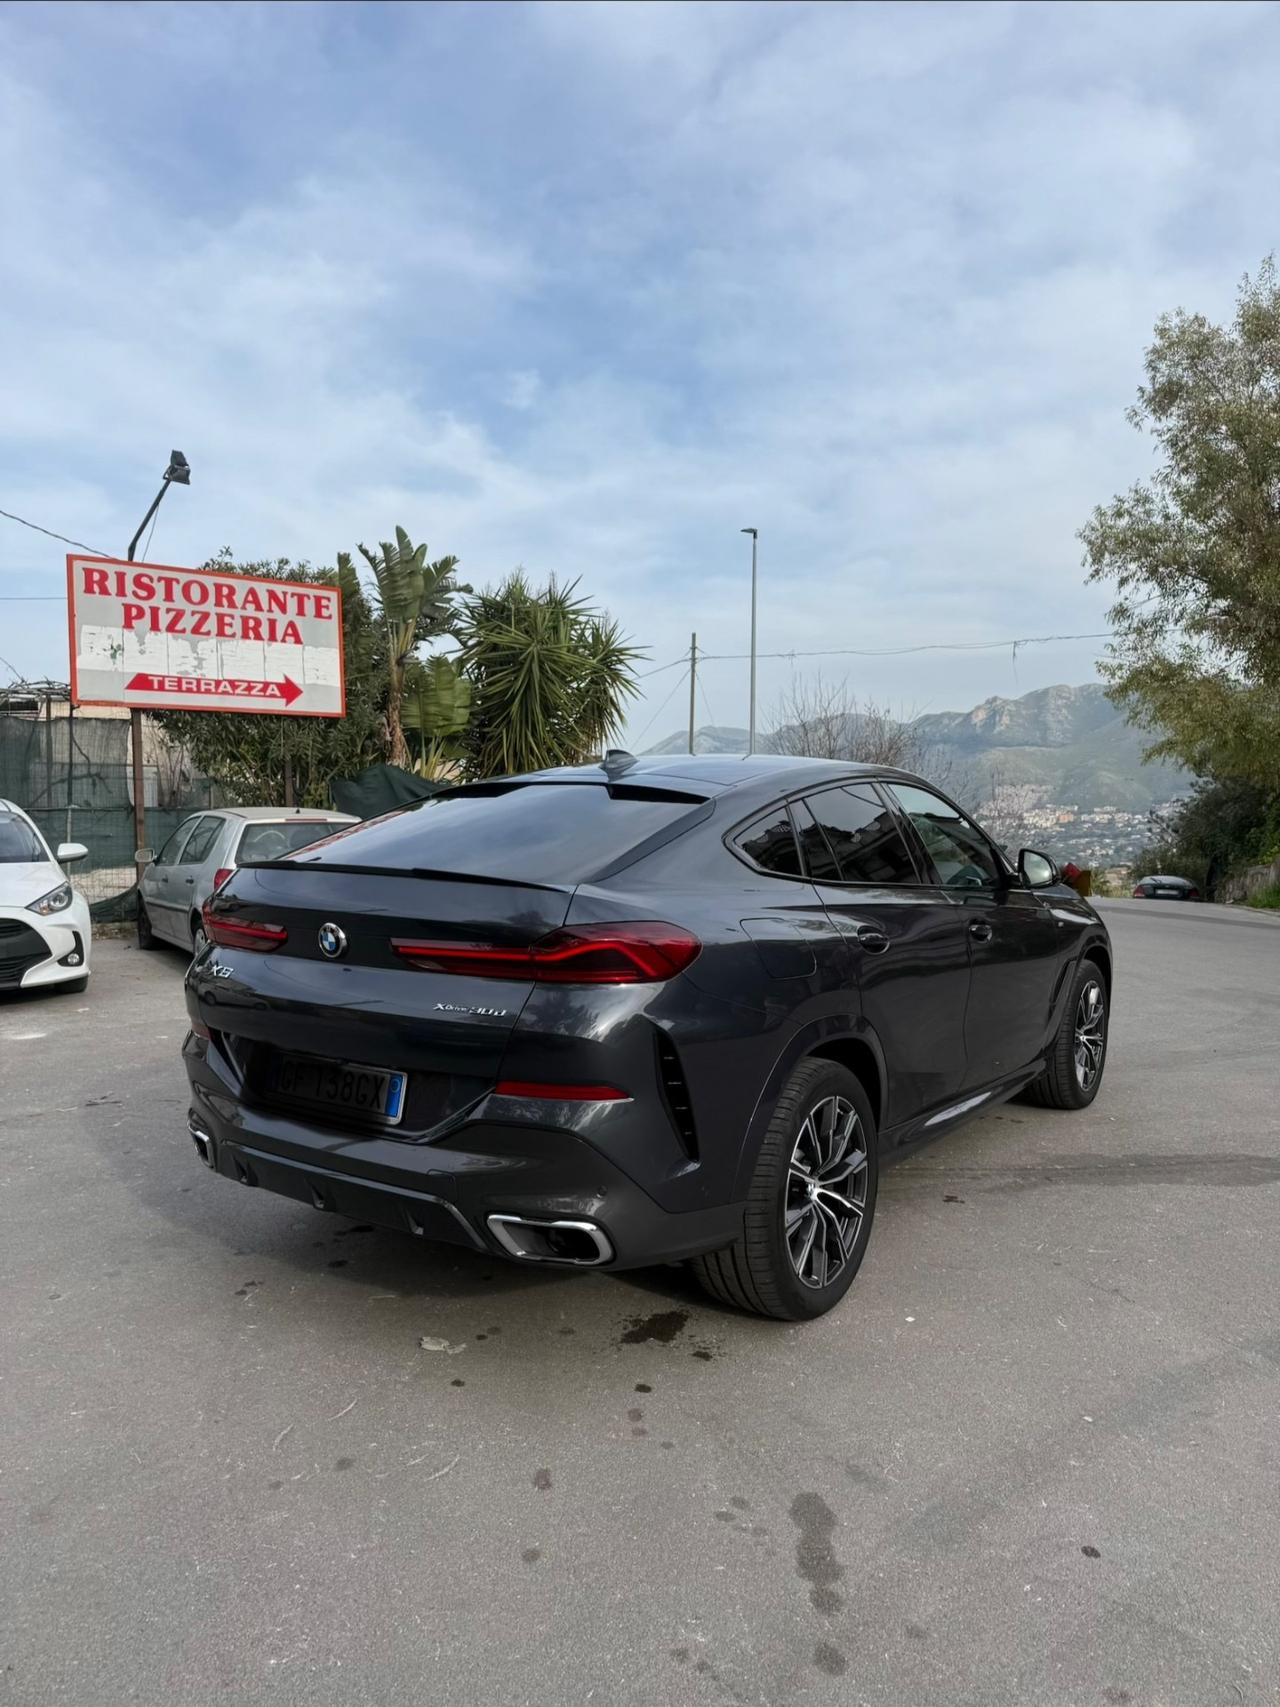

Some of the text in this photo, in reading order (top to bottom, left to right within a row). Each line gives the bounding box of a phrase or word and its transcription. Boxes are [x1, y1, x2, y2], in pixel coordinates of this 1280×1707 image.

[82, 567, 333, 620] RISTORANTE
[122, 603, 304, 645] PIZZERIA
[148, 675, 282, 697] TERRAZZA
